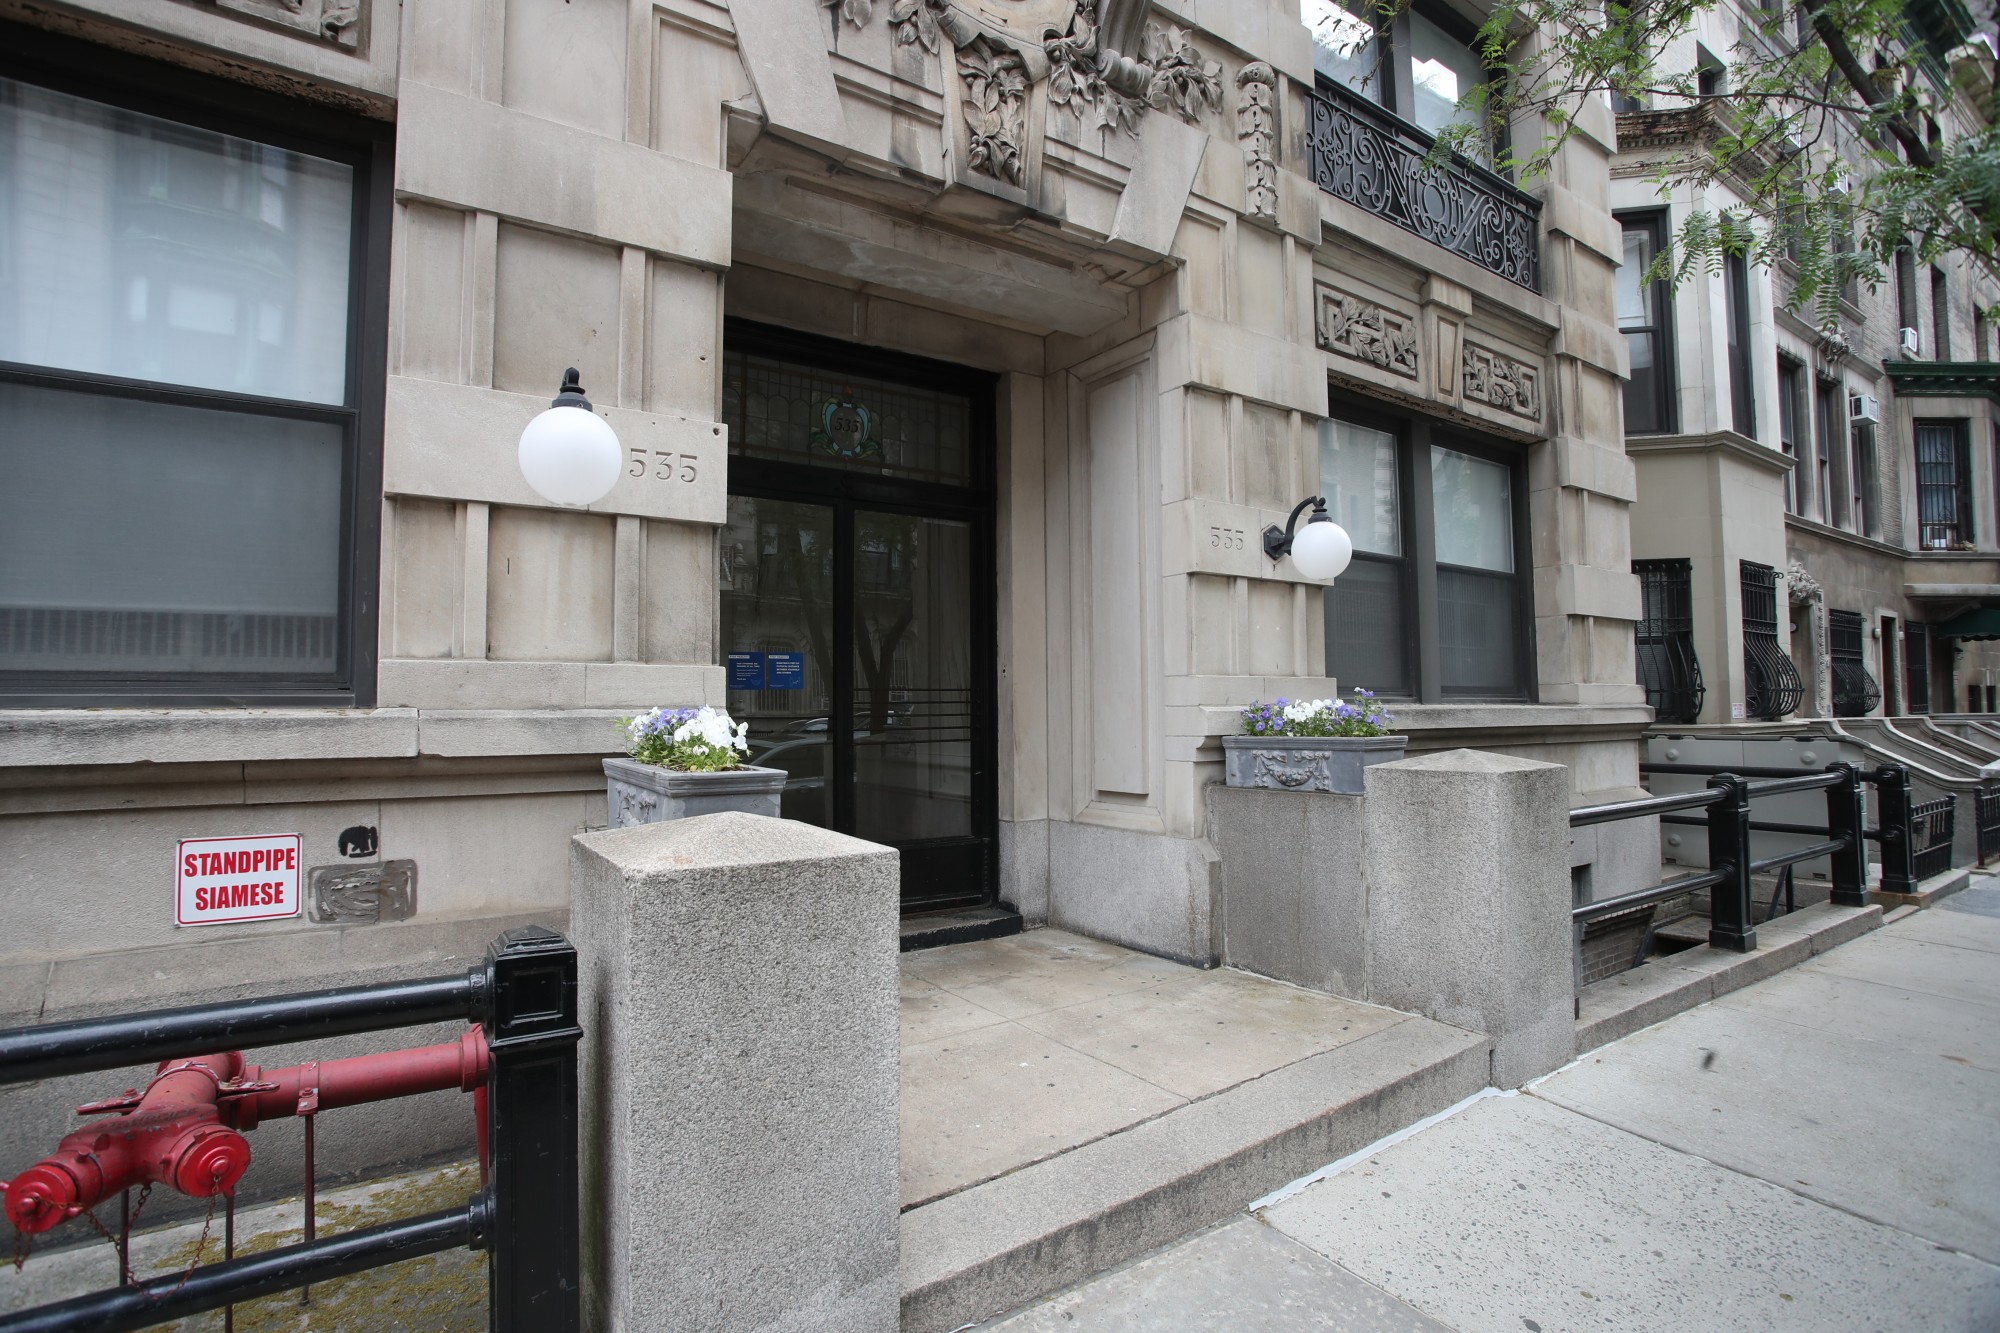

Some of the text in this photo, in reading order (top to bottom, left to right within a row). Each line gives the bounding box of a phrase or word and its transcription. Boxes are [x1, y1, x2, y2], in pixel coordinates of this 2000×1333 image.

[834, 417, 860, 433] 535
[629, 447, 698, 483] 535
[1210, 526, 1244, 551] 535
[184, 847, 296, 878] STANDPIPE
[195, 881, 285, 911] SIAMESE
